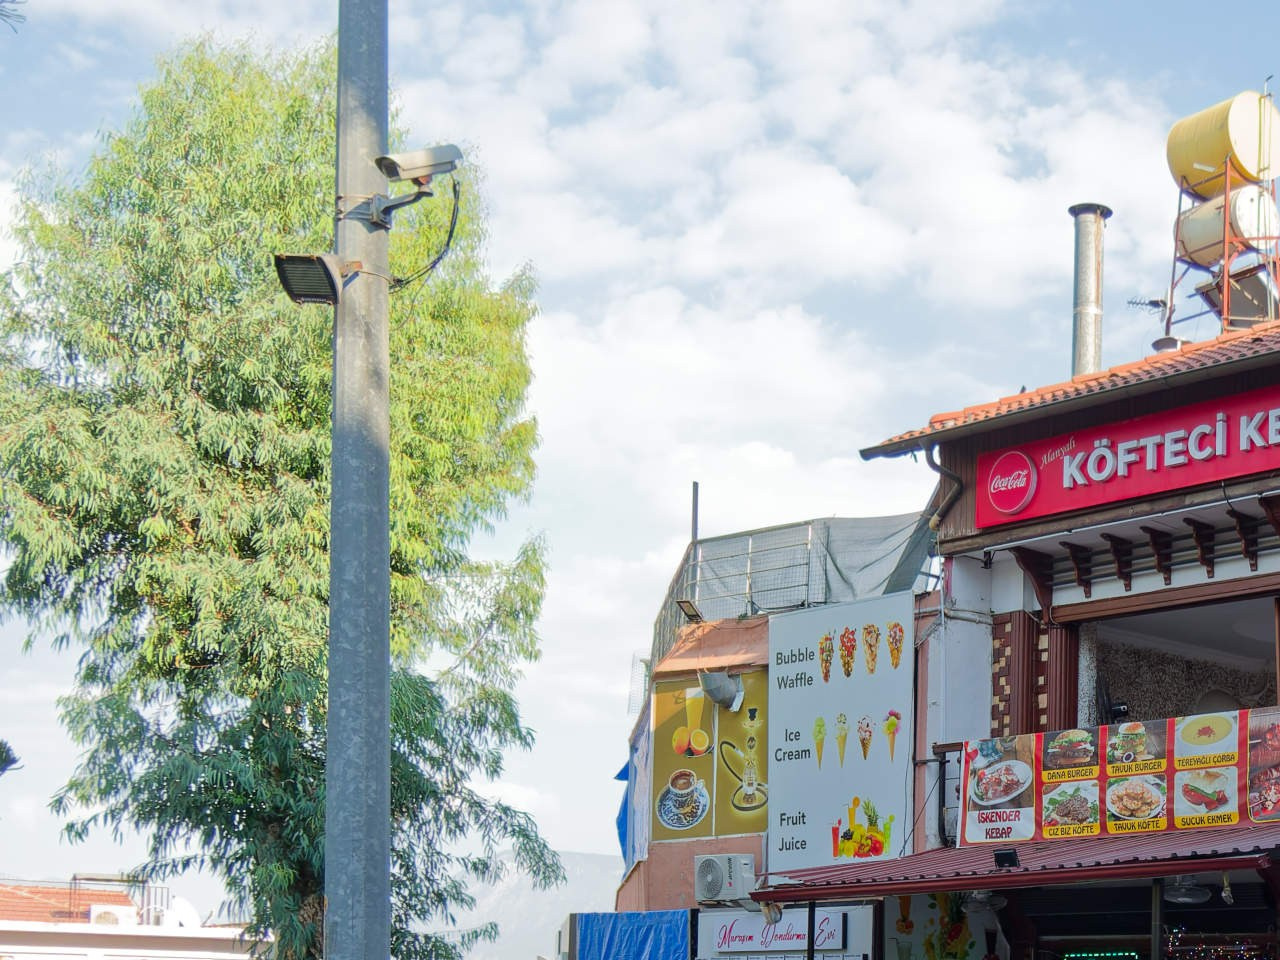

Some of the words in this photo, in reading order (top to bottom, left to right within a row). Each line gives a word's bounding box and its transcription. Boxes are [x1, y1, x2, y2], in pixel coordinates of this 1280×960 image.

[1062, 411, 1228, 489] KÖFTECİ
[775, 648, 815, 666] Bubble
[777, 675, 814, 690] Waffle
[784, 729, 801, 742] Ice
[774, 747, 811, 762] Cream
[1212, 751, 1236, 765] ÇORBA
[1047, 771, 1066, 781] DANA
[1067, 768, 1094, 780] BURGER
[1134, 761, 1162, 773] BURGER
[779, 811, 806, 827] Fruit
[977, 809, 1021, 824] İSKENDER
[1181, 815, 1205, 827] SUCUK
[1206, 813, 1233, 825] EKMEK
[985, 826, 1013, 840] KEBAP
[778, 837, 807, 852] Juice
